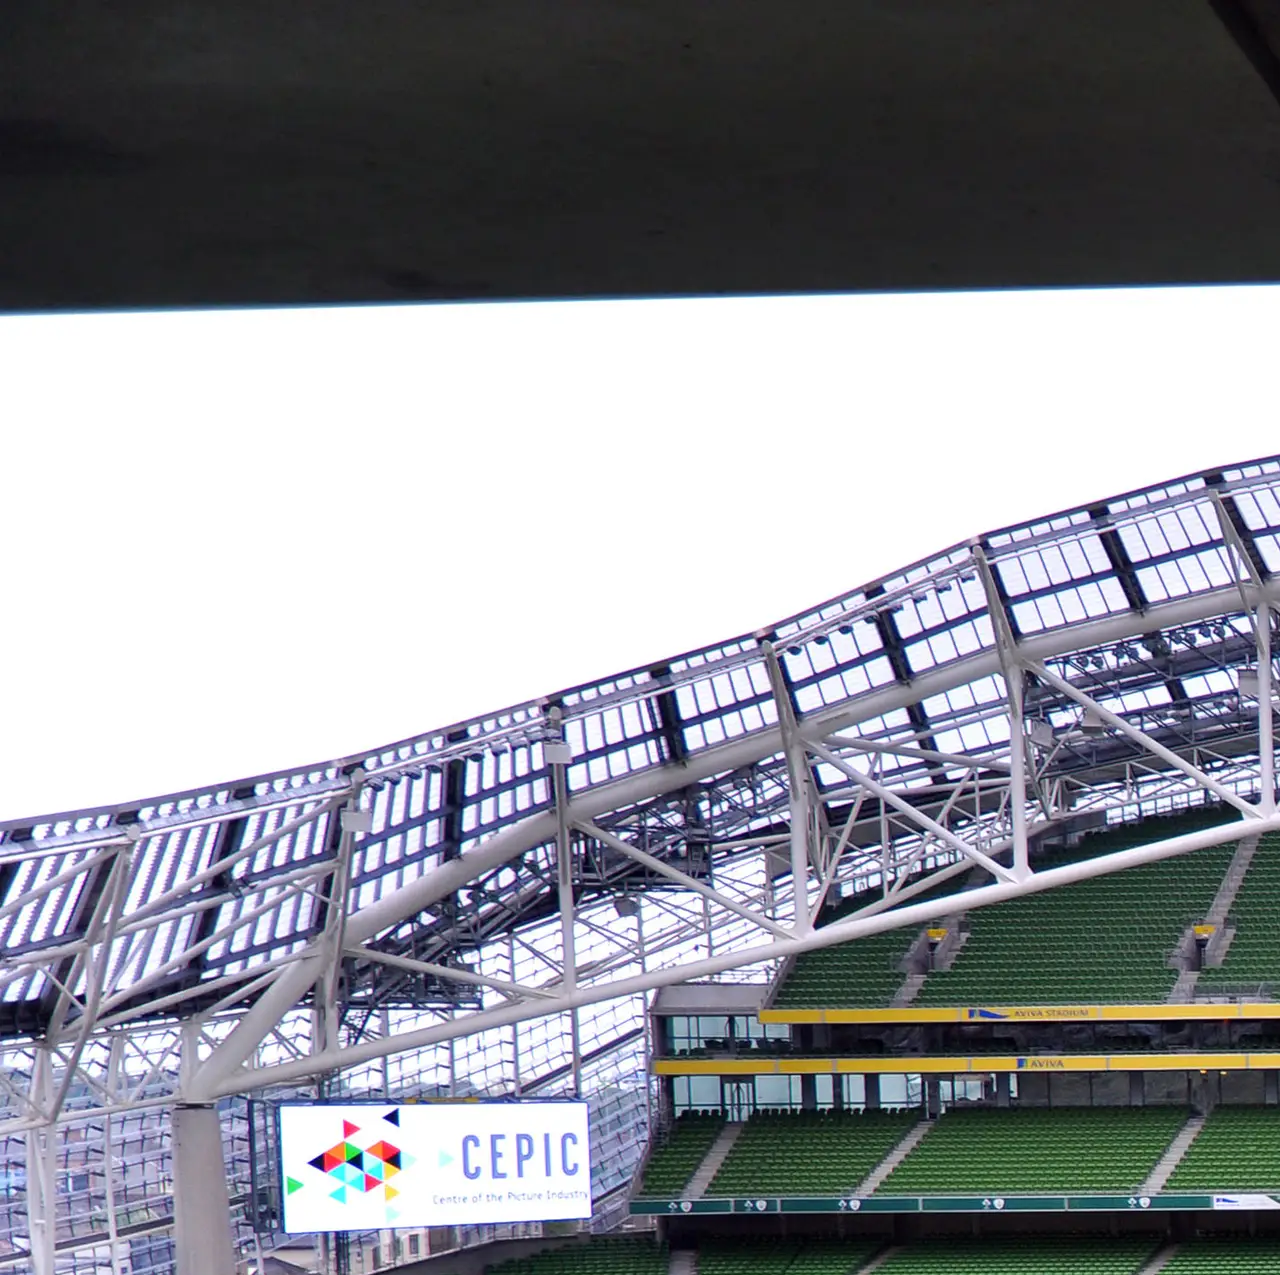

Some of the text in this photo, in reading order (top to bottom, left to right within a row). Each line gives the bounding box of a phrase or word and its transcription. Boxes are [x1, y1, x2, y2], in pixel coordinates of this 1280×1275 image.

[1014, 1009, 1089, 1018] AVIVA STADIUM
[1030, 1060, 1064, 1069] AVIVA
[462, 1132, 579, 1180] CEPIC
[432, 1194, 467, 1205] Centre
[472, 1194, 482, 1203] of
[486, 1193, 503, 1203] the
[508, 1191, 542, 1201] Picture
